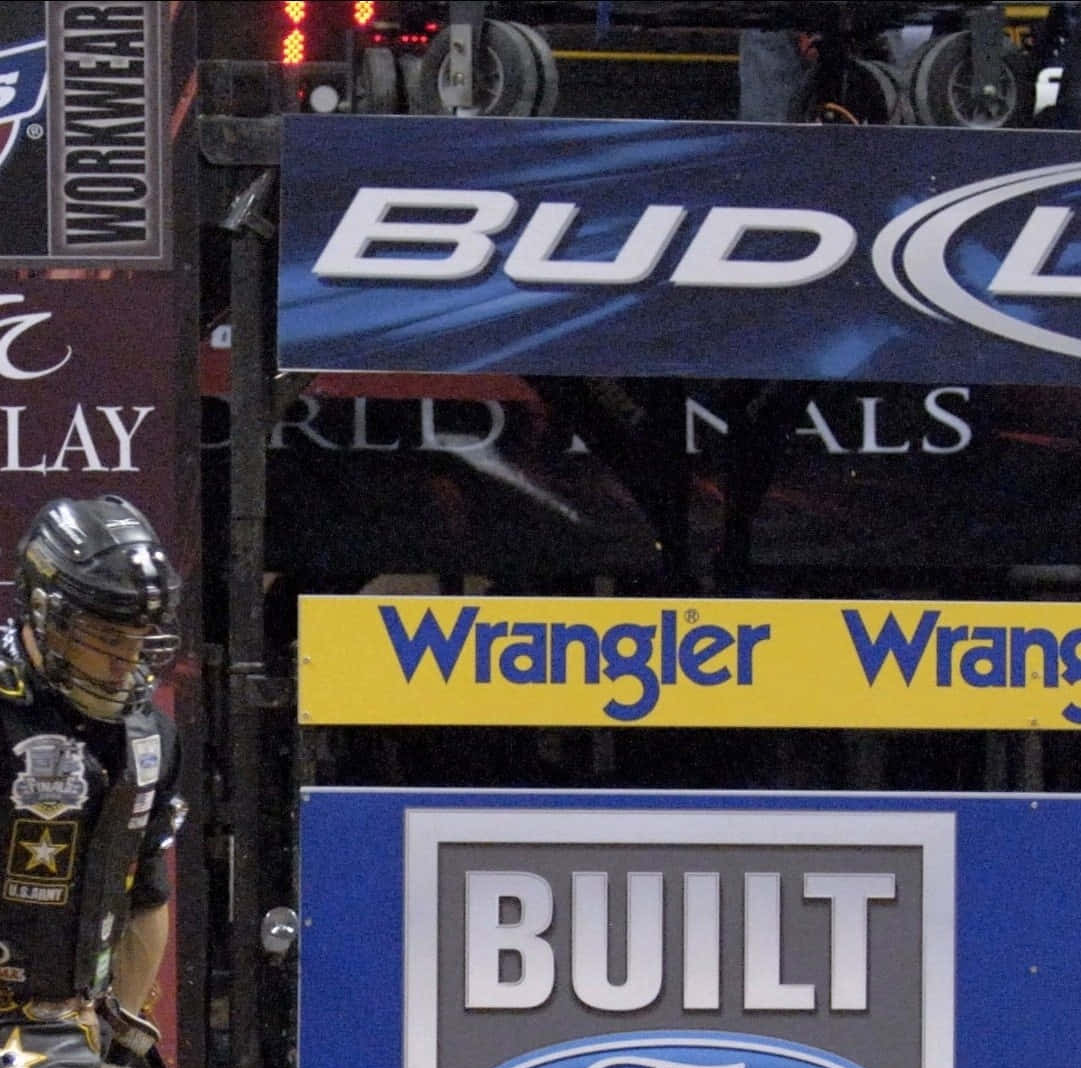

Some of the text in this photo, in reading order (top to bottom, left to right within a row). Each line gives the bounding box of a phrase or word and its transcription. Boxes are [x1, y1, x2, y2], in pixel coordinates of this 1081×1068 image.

[64, 4, 148, 246] WORKWEAR
[312, 186, 858, 288] BUD
[377, 605, 771, 722] Wrangler
[465, 870, 897, 1011] BUILT
